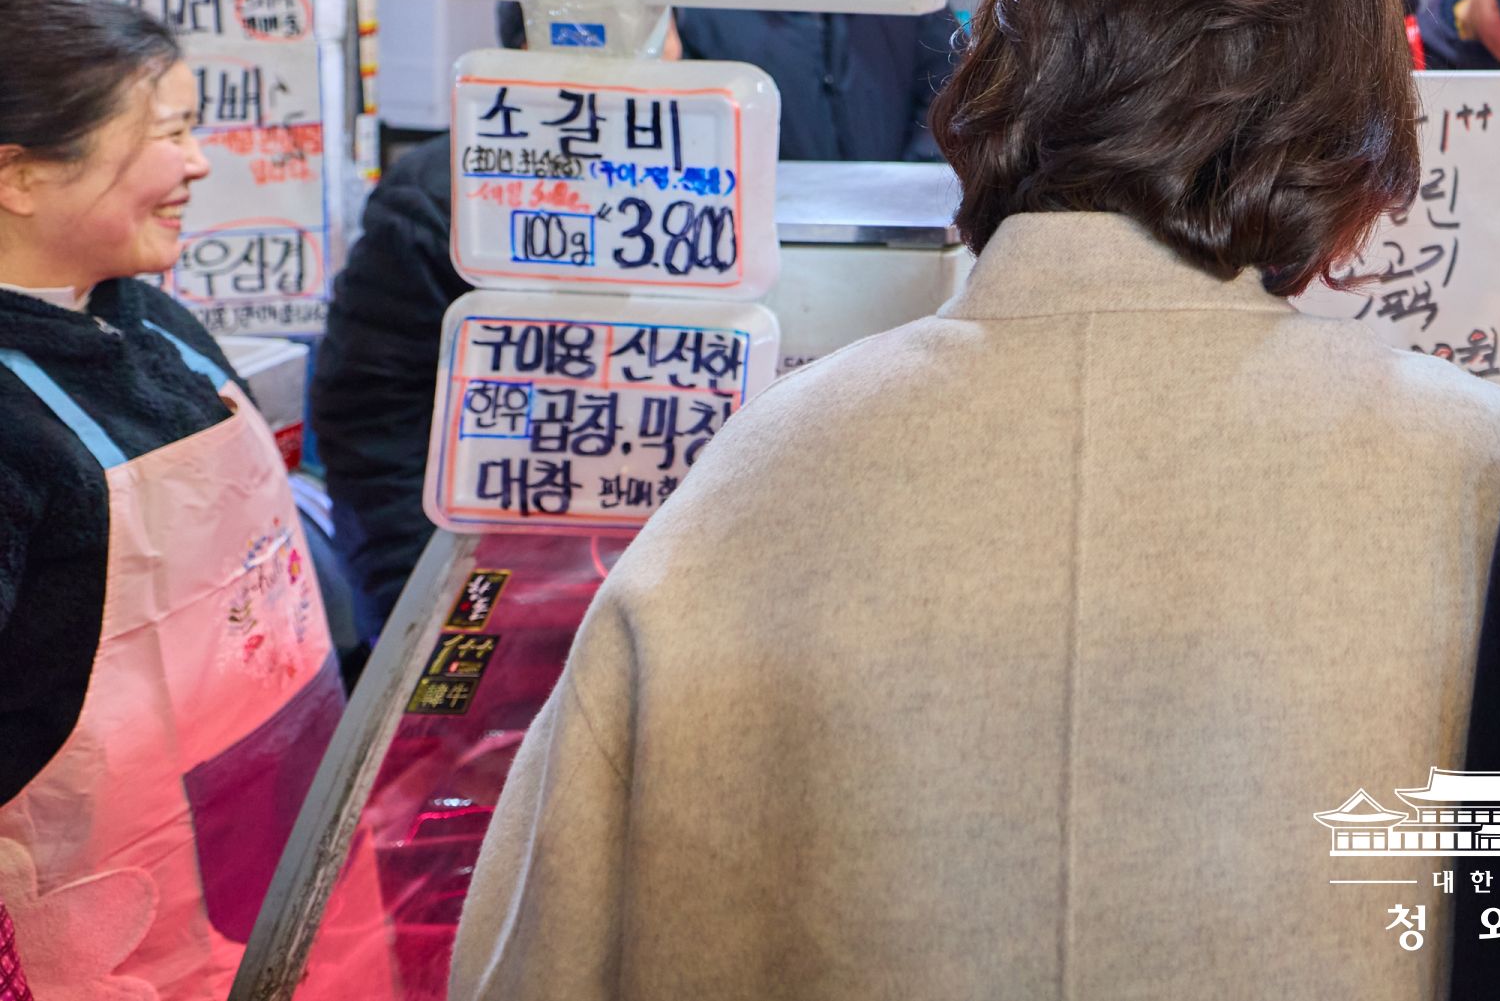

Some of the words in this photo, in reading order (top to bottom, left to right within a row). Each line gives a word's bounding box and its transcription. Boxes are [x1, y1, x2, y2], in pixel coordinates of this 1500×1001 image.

[523, 214, 592, 266] 100g
[472, 324, 597, 379] 구이용
[609, 326, 744, 400] 신선한
[467, 385, 529, 432] 한우
[476, 457, 584, 517] 대창
